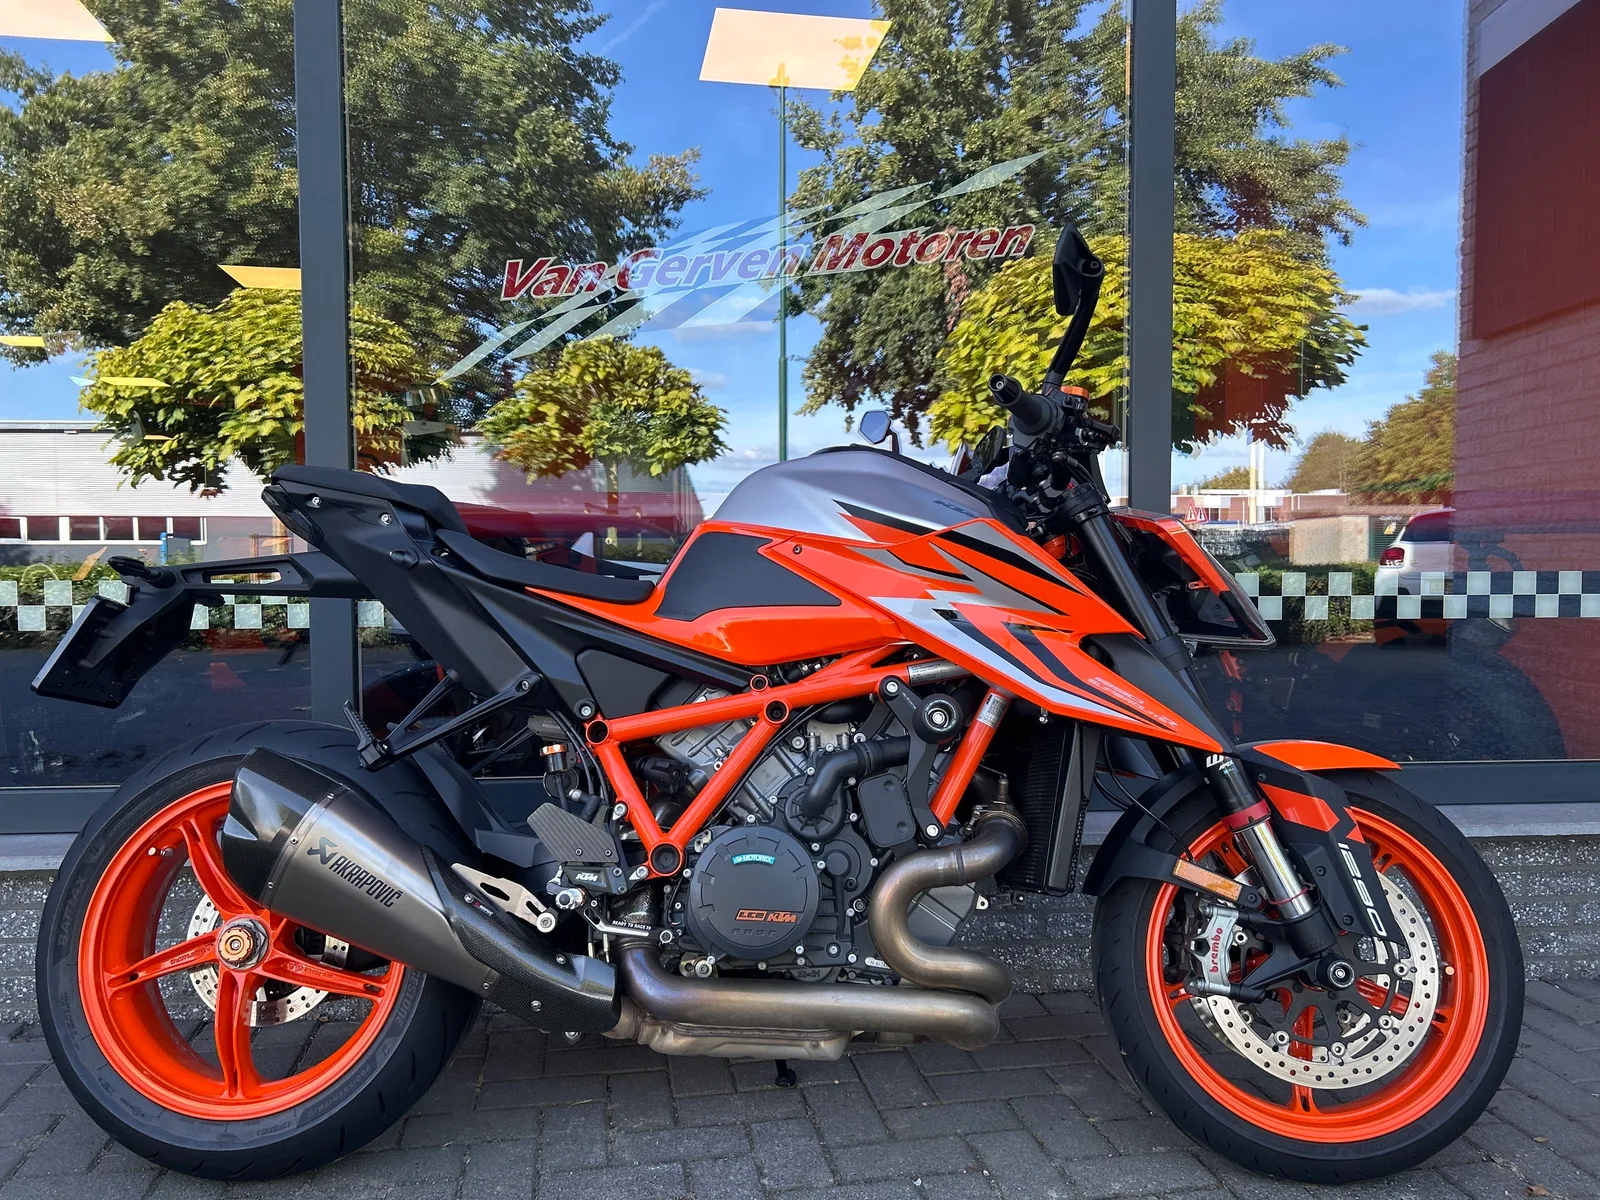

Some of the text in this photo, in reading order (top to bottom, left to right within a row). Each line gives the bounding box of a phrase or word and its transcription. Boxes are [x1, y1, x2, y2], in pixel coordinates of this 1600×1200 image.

[501, 224, 1035, 301] Van Gerven Motoren
[329, 855, 404, 908] AKRAPOVIČ
[575, 872, 599, 882] KTM
[1337, 842, 1388, 937] 1290
[766, 912, 797, 923] KTM
[1209, 927, 1223, 973] brembo
